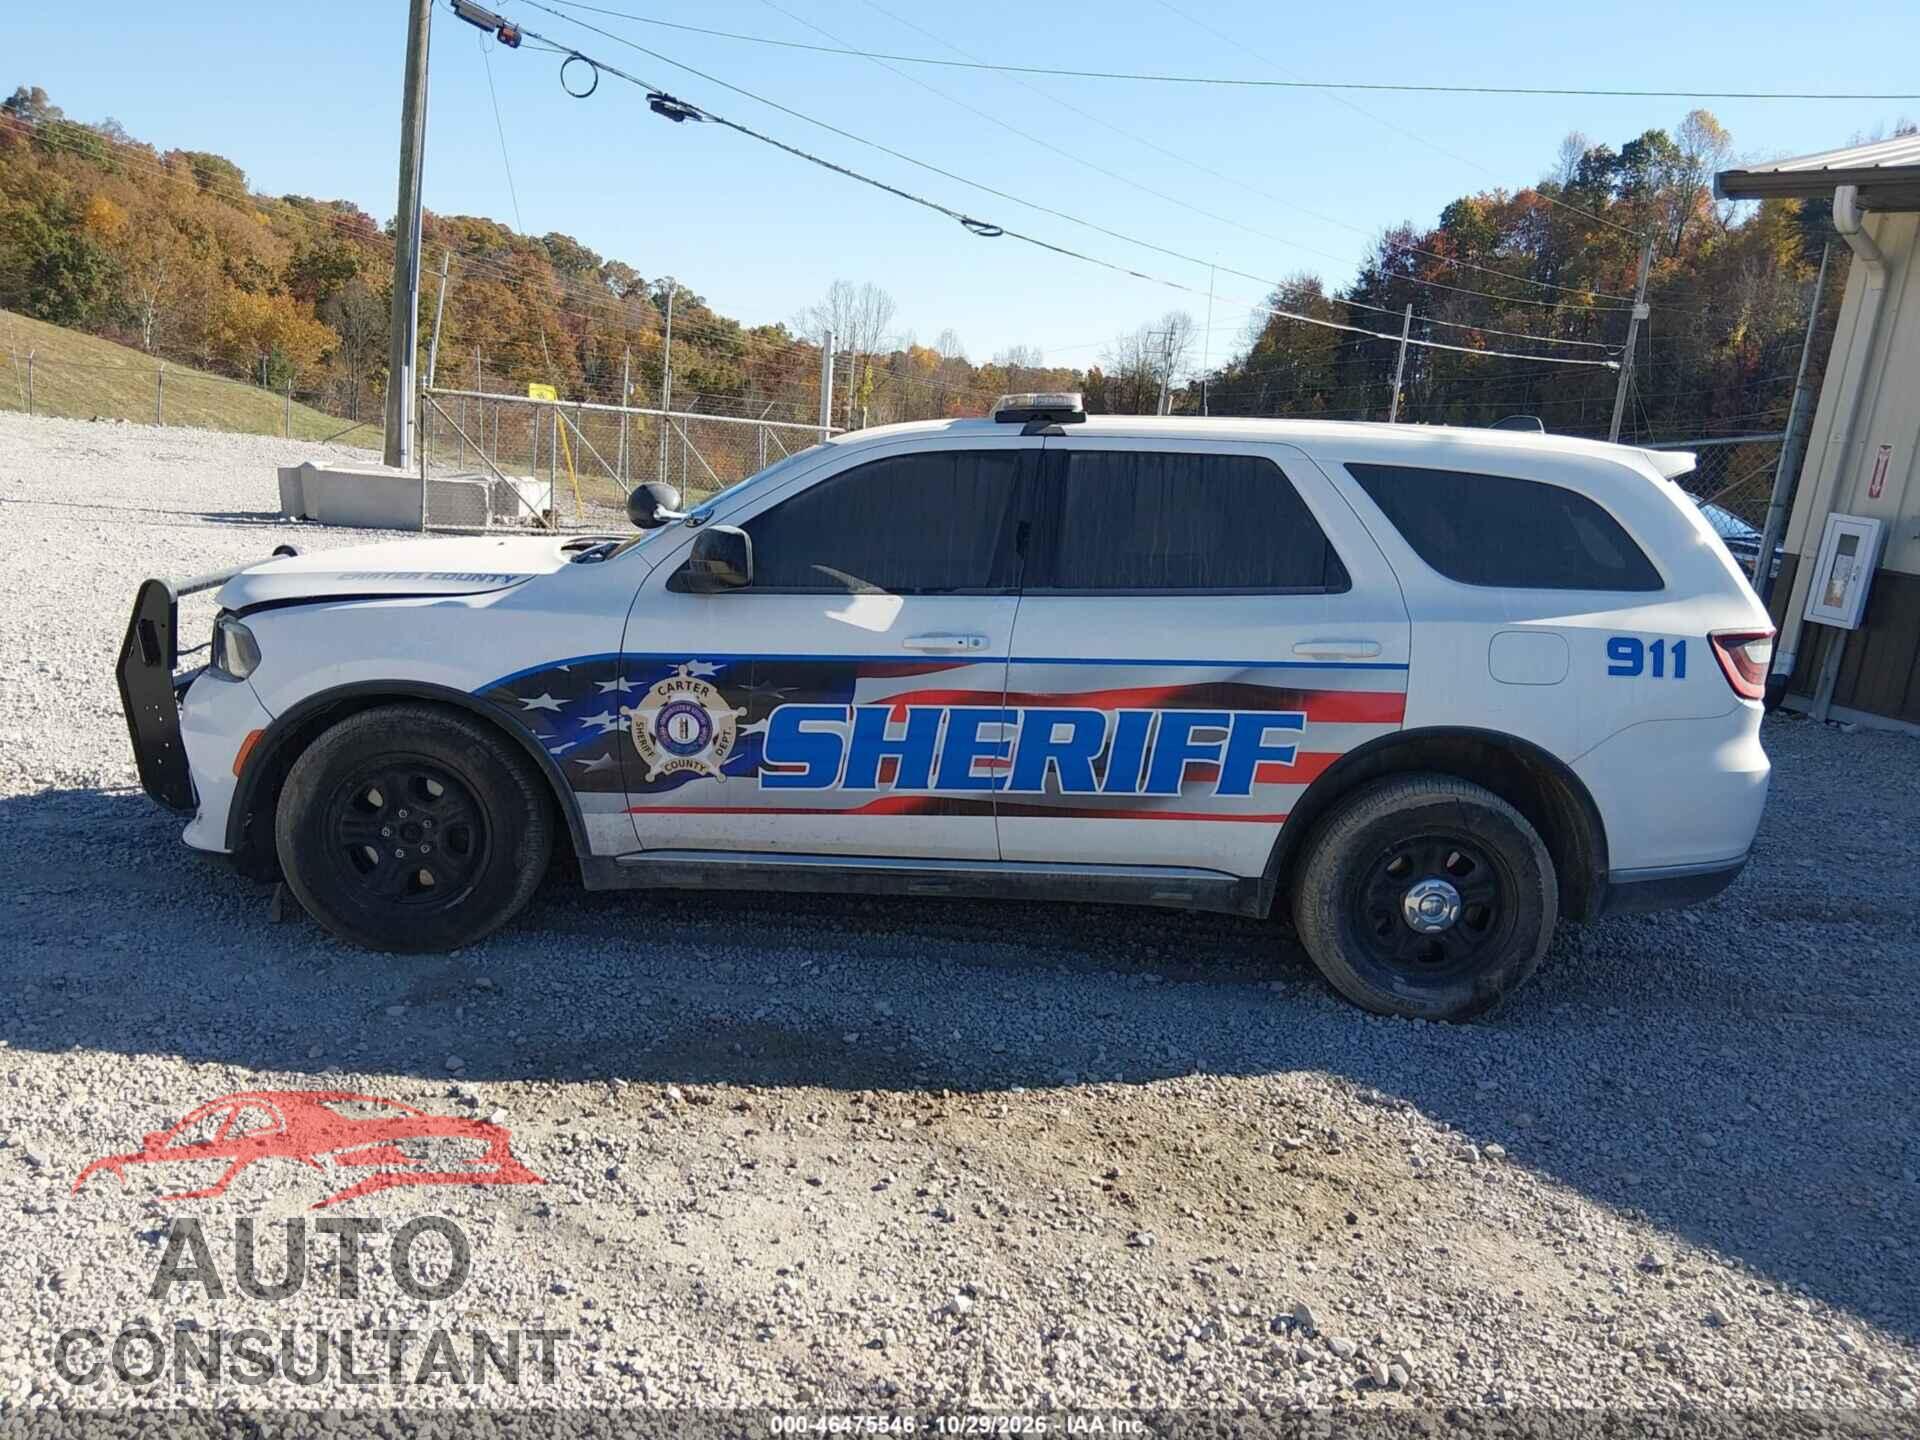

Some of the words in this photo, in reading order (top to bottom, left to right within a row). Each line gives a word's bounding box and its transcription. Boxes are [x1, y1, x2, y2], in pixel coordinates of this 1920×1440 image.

[424, 572, 518, 584] COUNTY
[1607, 637, 1686, 678] 911
[657, 681, 710, 697] CARTER
[635, 720, 656, 758] SHERIFF
[759, 703, 1307, 797] SHERIFF
[664, 759, 707, 772] COUNTY
